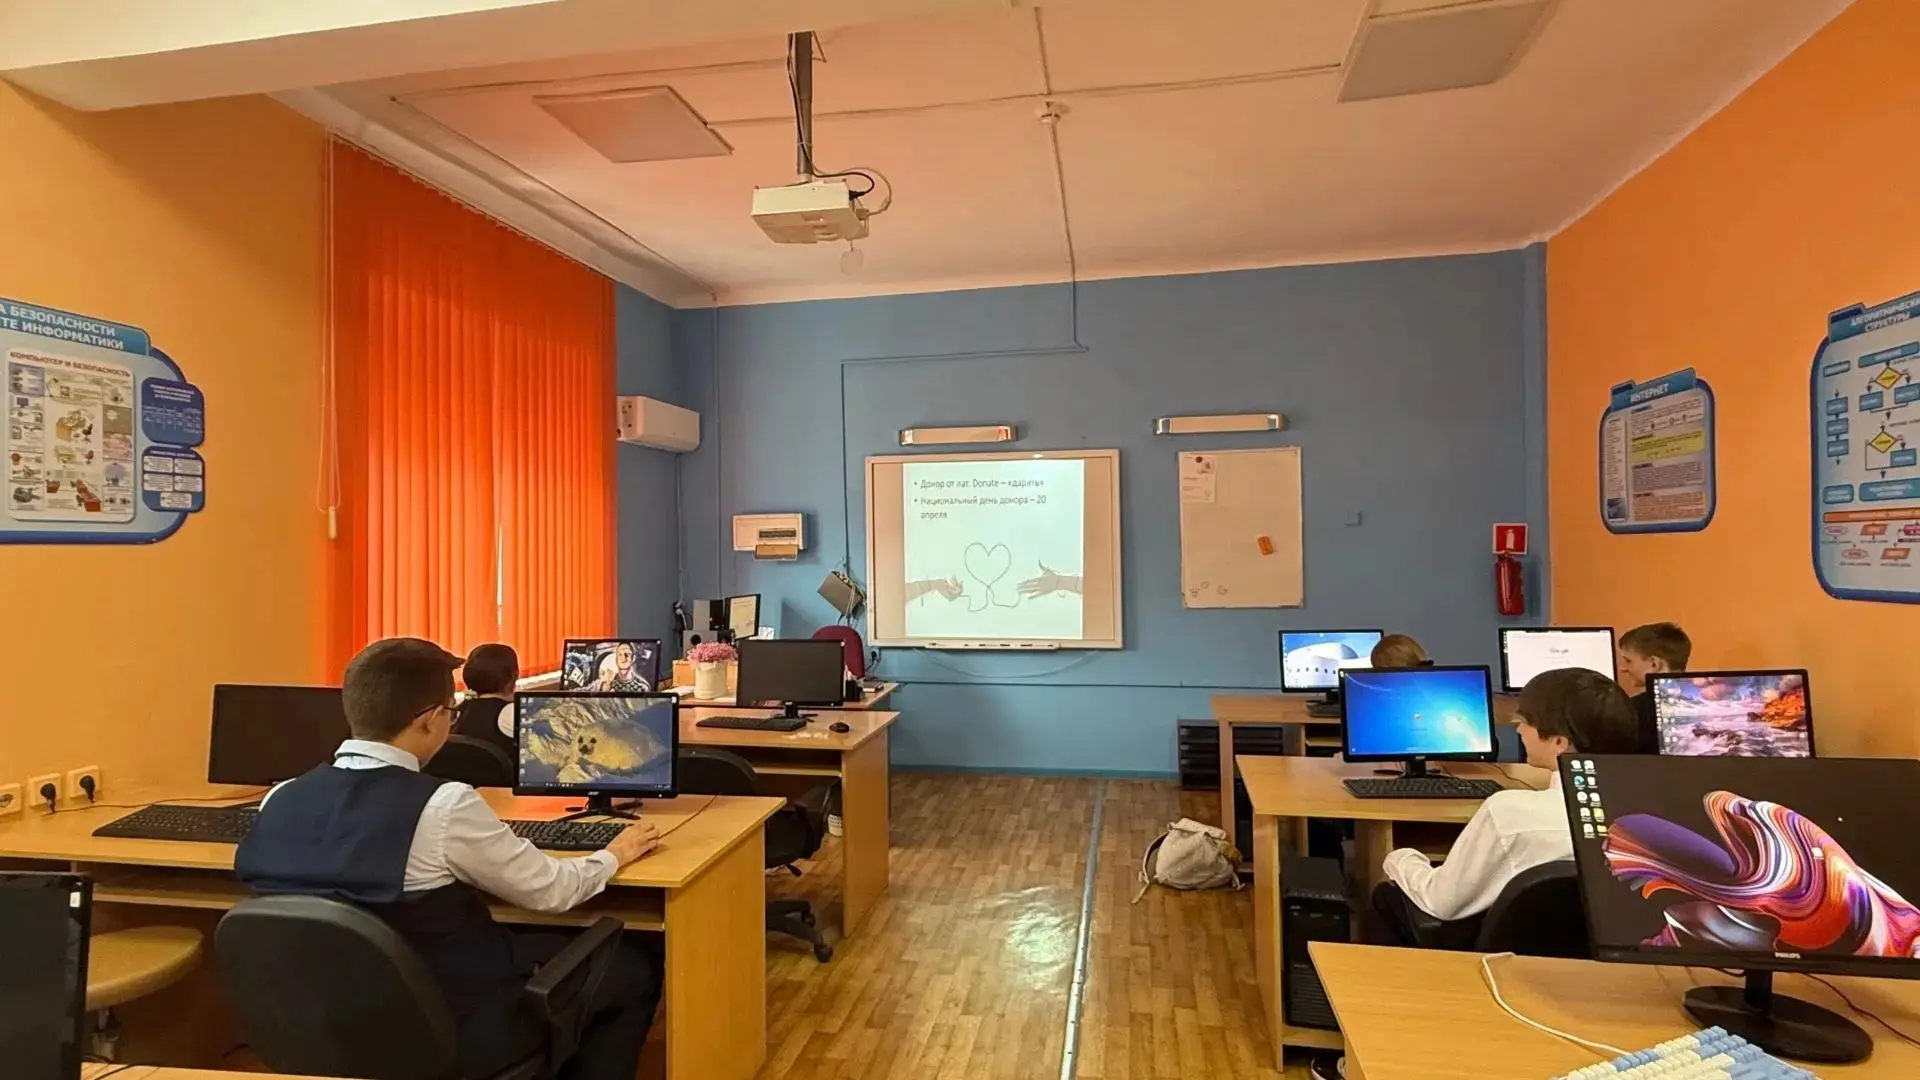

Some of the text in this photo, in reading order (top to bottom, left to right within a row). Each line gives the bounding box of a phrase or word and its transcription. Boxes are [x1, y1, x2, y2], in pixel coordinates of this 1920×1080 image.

[10, 305, 116, 337] БЕЗОПАСНОСТИ
[22, 320, 124, 350] ИНФОРМАТИКИ
[10, 351, 63, 366] КОМПЬЮТЕР
[73, 362, 131, 378] БЕЗОПАСНОСТЬ
[920, 479, 945, 490] Донор
[946, 480, 954, 488] от
[956, 480, 971, 488] лат.
[972, 478, 999, 488] Donate
[920, 495, 978, 506] Национальный
[979, 497, 998, 506] день
[999, 496, 1028, 506] донора
[1036, 494, 1047, 504] 20
[920, 511, 948, 520] апреля
